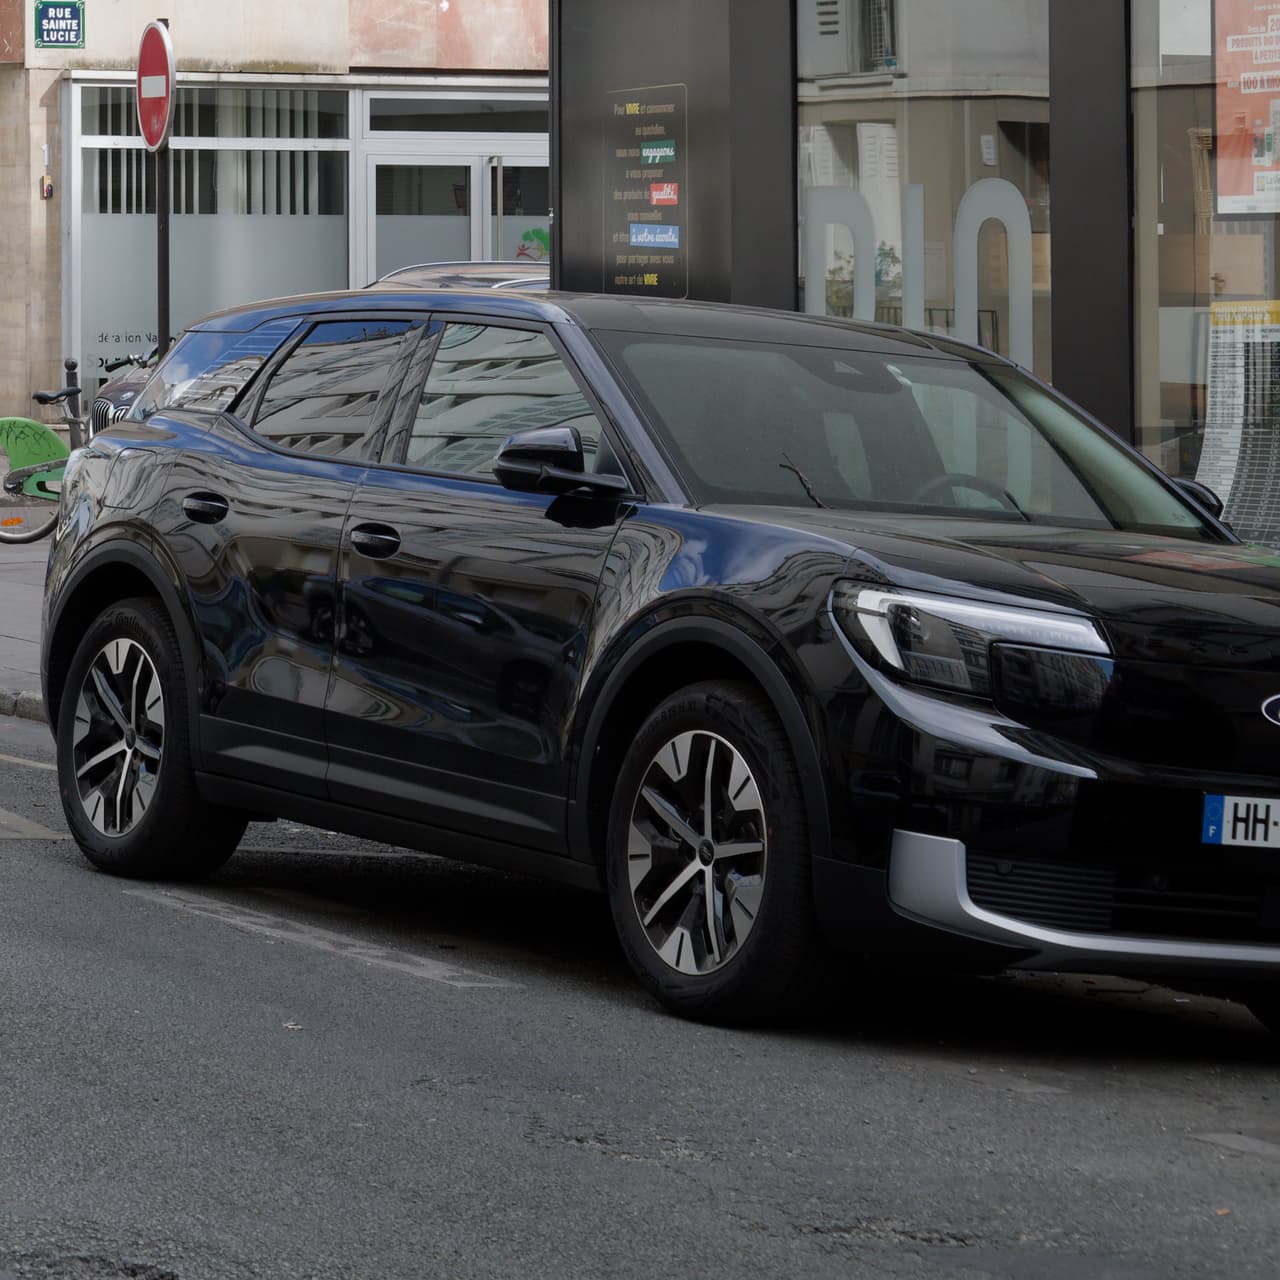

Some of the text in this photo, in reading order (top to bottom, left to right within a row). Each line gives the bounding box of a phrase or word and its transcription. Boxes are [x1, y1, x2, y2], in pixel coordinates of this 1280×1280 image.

[48, 7, 72, 18] RUE
[42, 19, 78, 30] SAINTE
[43, 31, 77, 41] LUCIE
